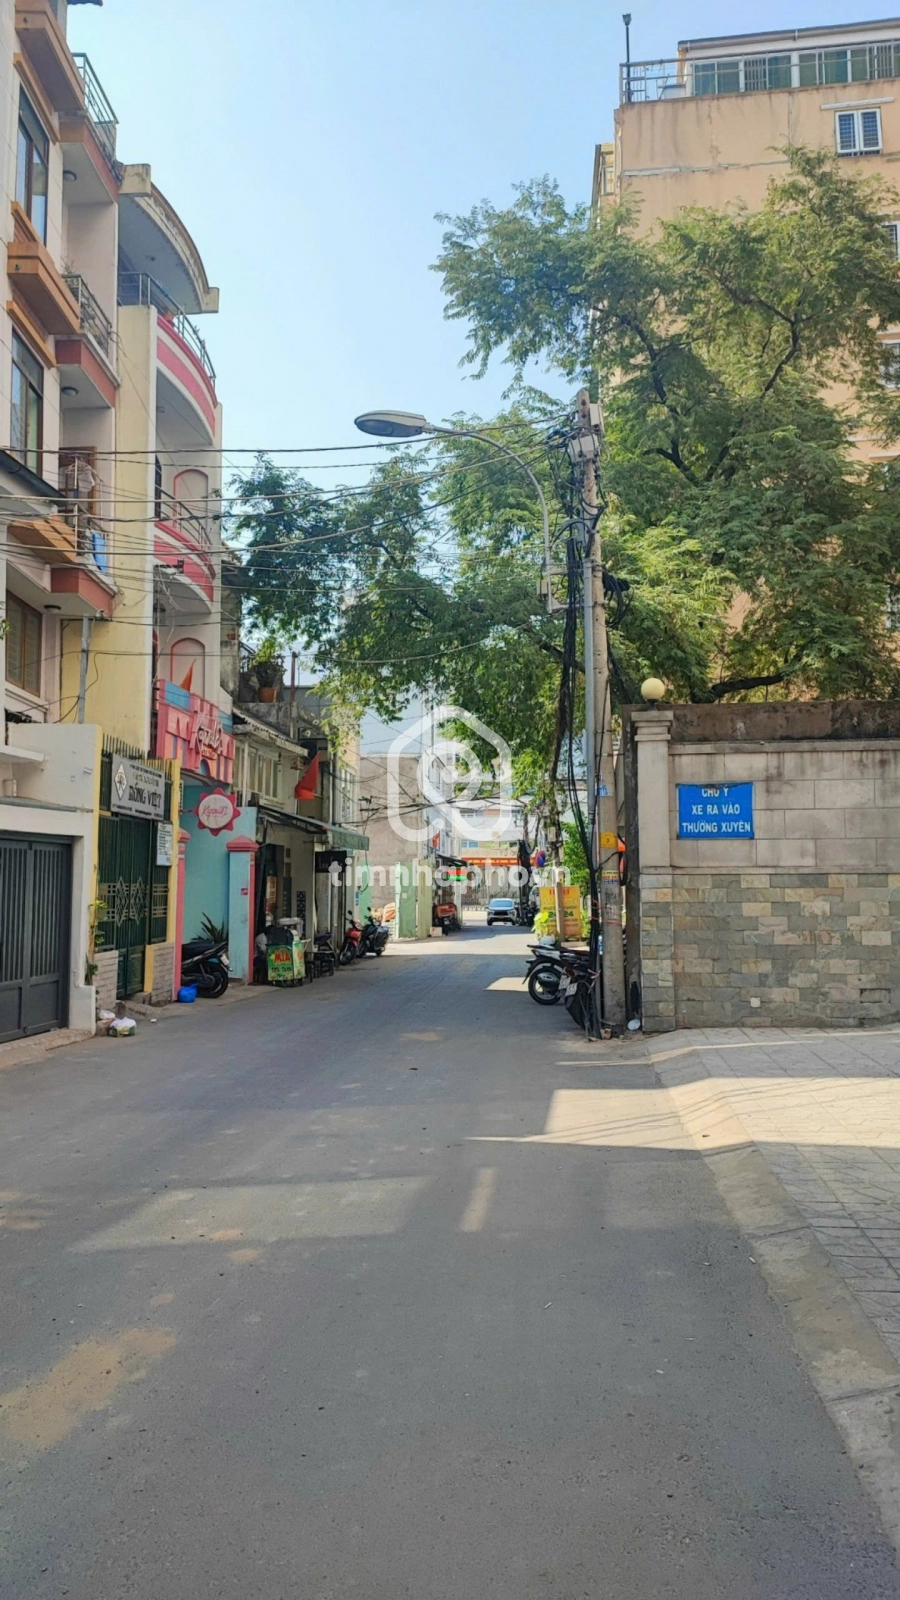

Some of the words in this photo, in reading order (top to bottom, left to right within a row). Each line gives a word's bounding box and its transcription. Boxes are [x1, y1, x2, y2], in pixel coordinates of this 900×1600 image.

[691, 804, 704, 815] XE
[706, 804, 719, 815] RA
[721, 802, 740, 815] VÀO
[682, 820, 718, 833] THƯỜNG
[720, 819, 751, 833] XUYÊN
